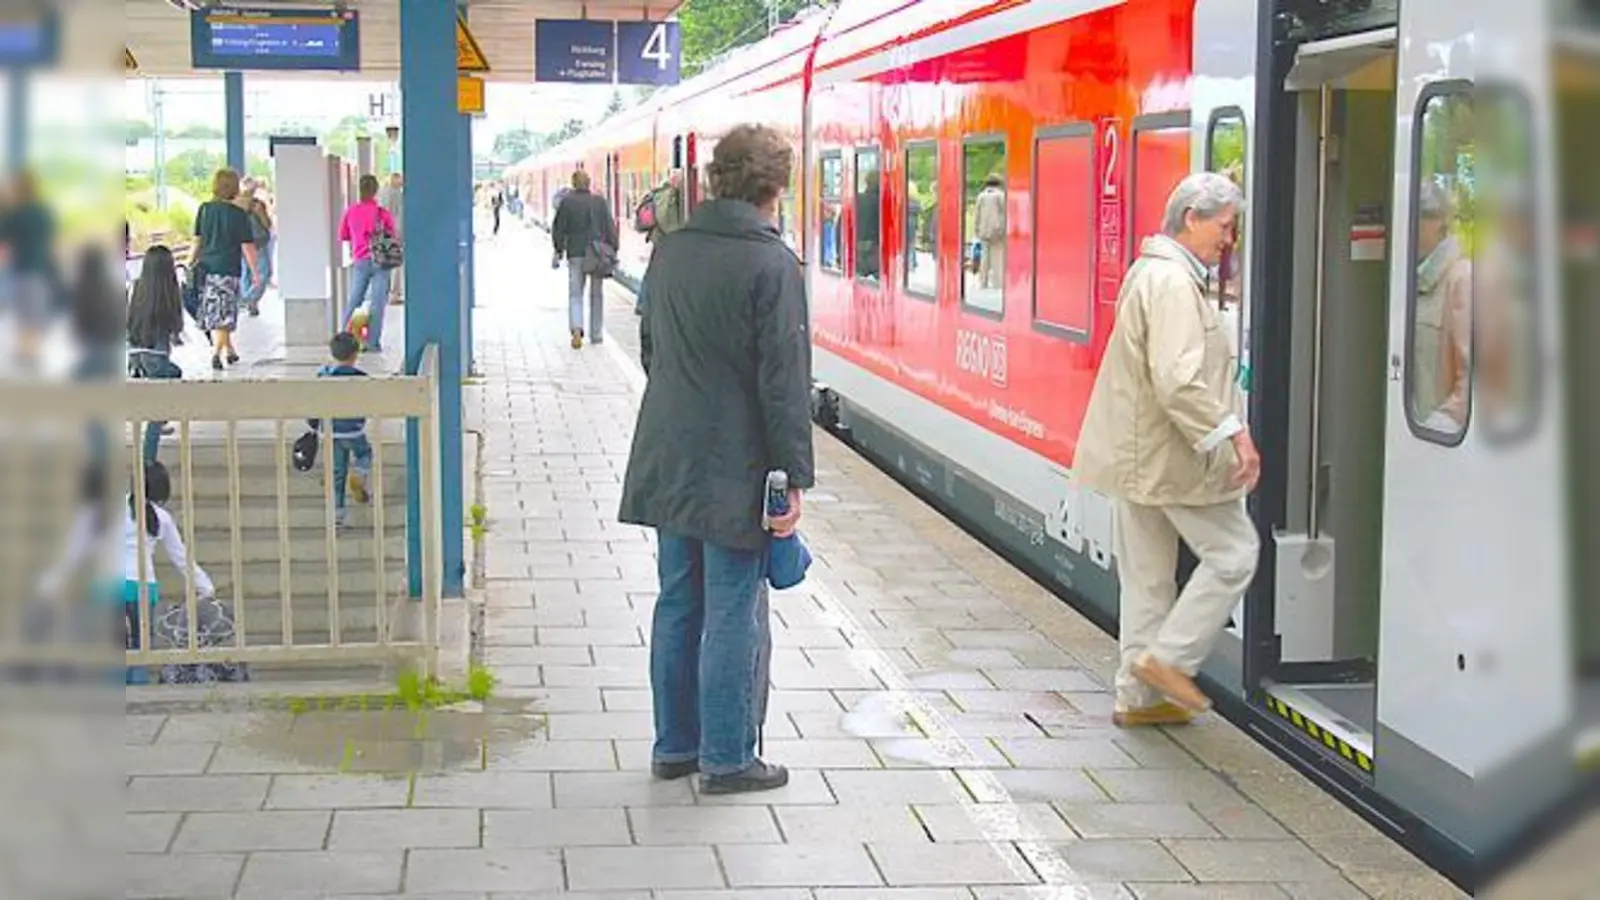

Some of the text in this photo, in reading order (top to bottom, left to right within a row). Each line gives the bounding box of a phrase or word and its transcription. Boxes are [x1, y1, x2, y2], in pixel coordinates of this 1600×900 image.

[641, 23, 672, 70] 4
[369, 93, 384, 116] H
[1104, 124, 1118, 195] 2
